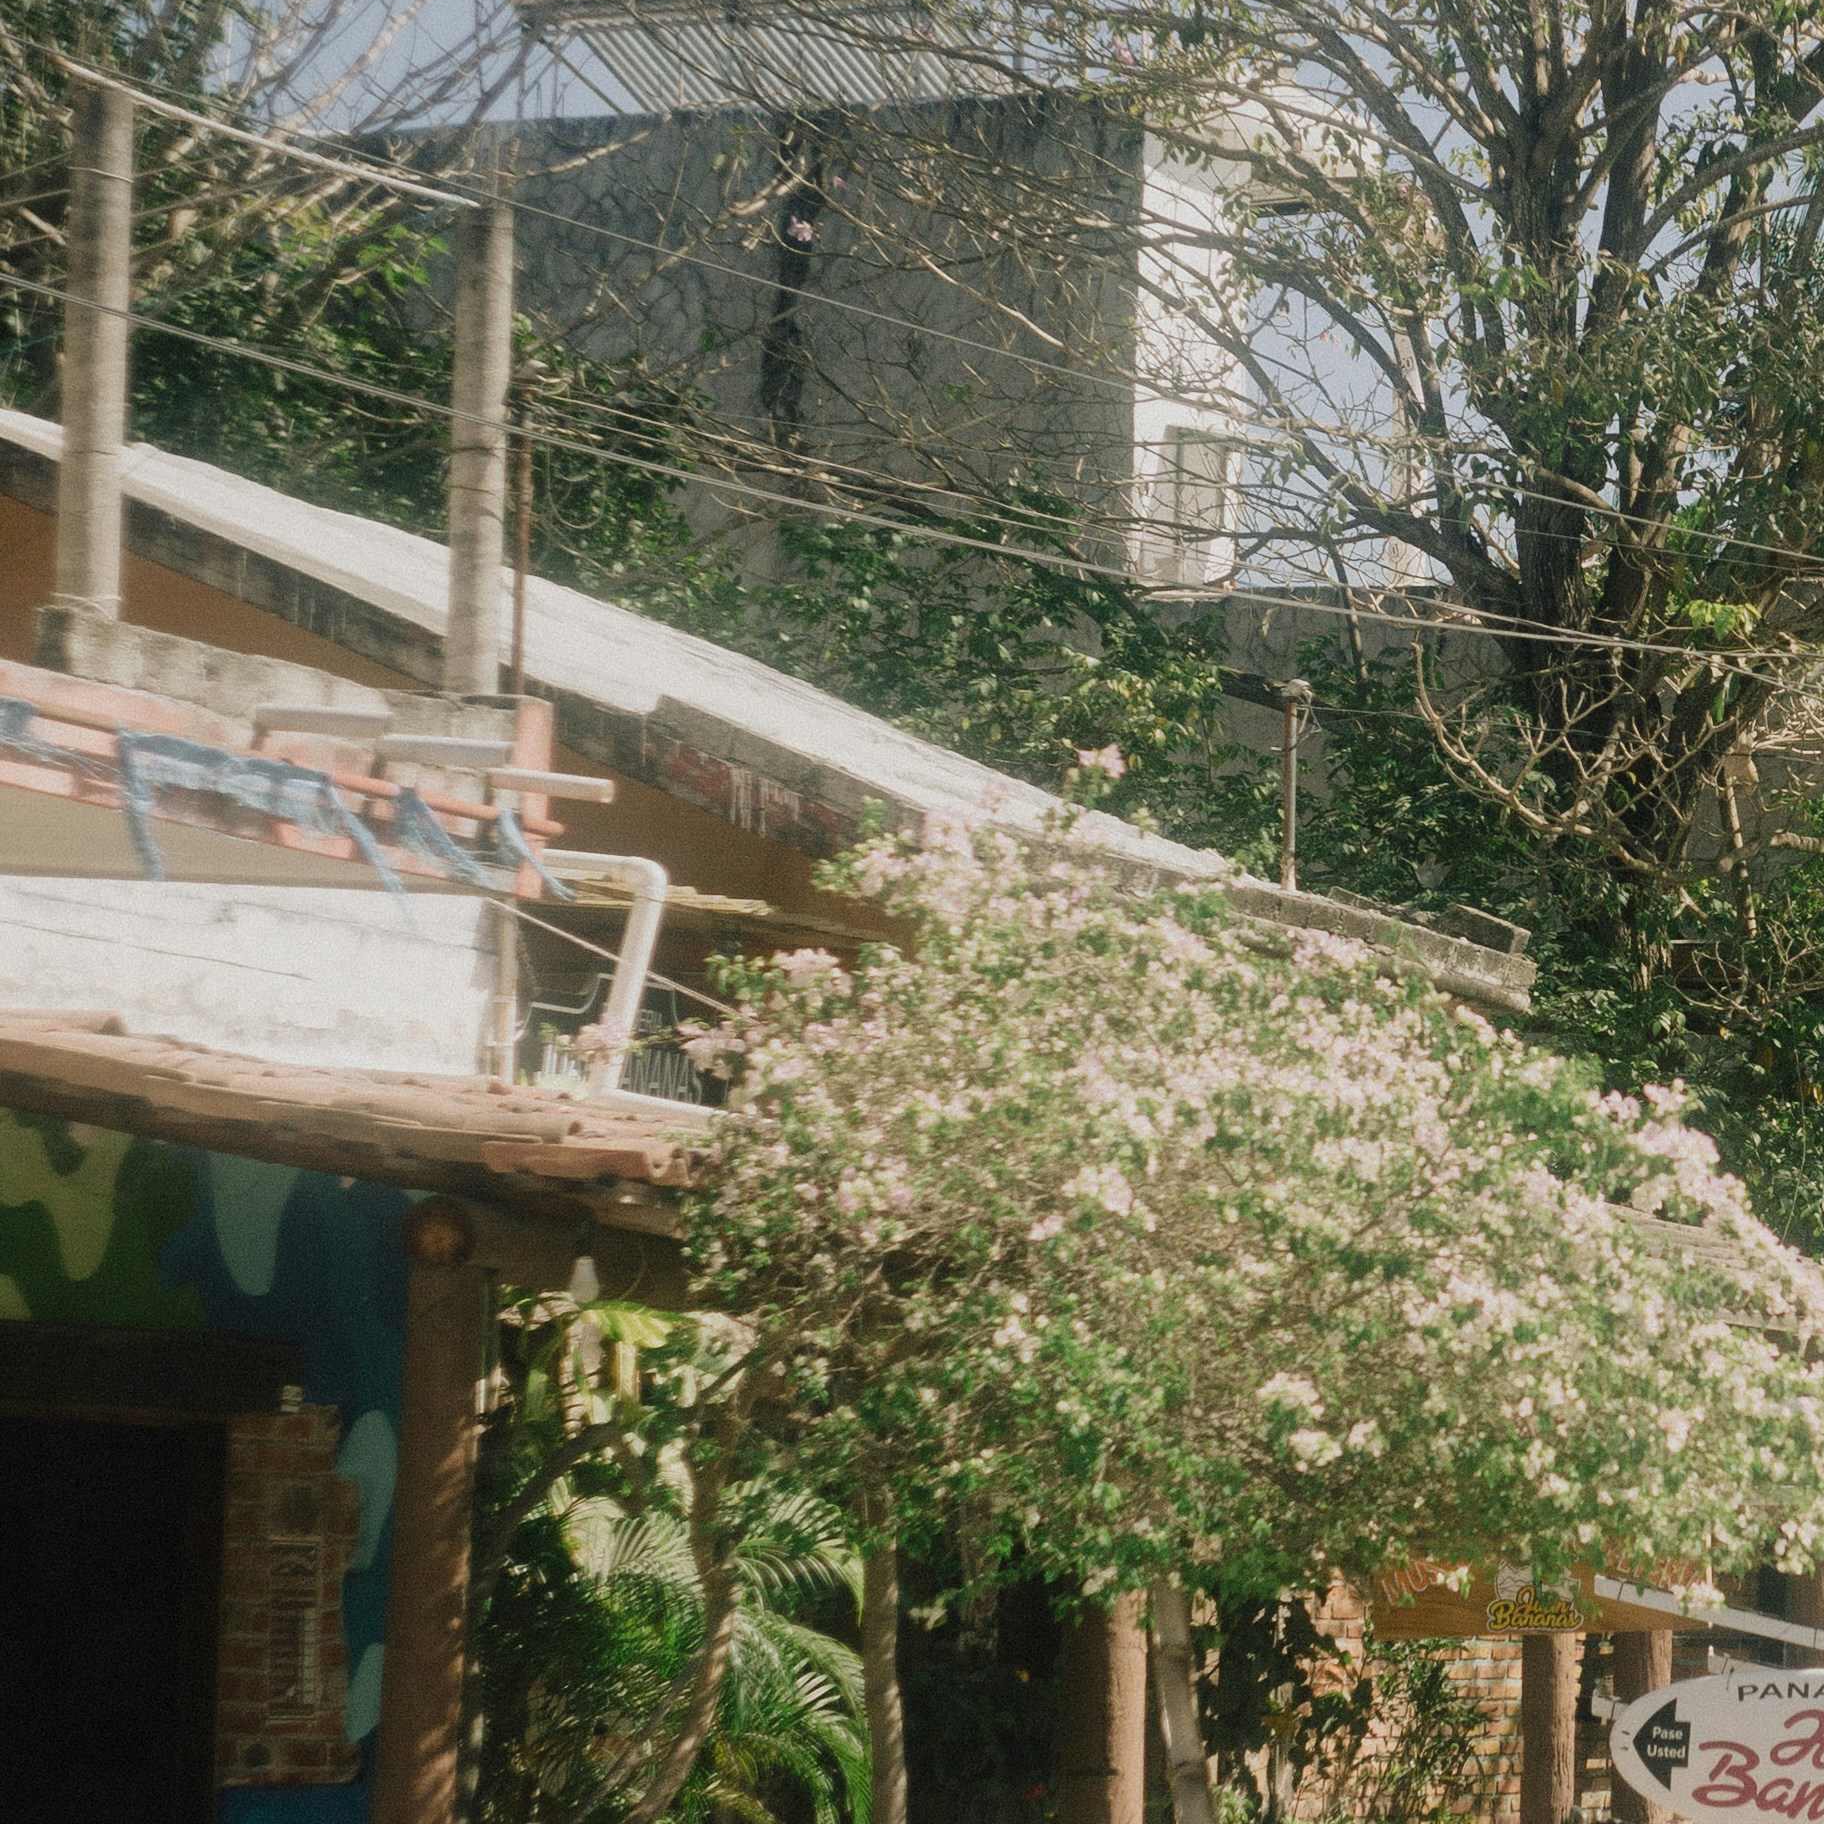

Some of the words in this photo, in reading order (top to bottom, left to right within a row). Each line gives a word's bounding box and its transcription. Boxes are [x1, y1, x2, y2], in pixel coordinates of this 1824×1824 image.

[1489, 1599, 1578, 1630] Bananas
[1652, 1725, 1684, 1740] Pase
[1646, 1744, 1686, 1759] Usted
